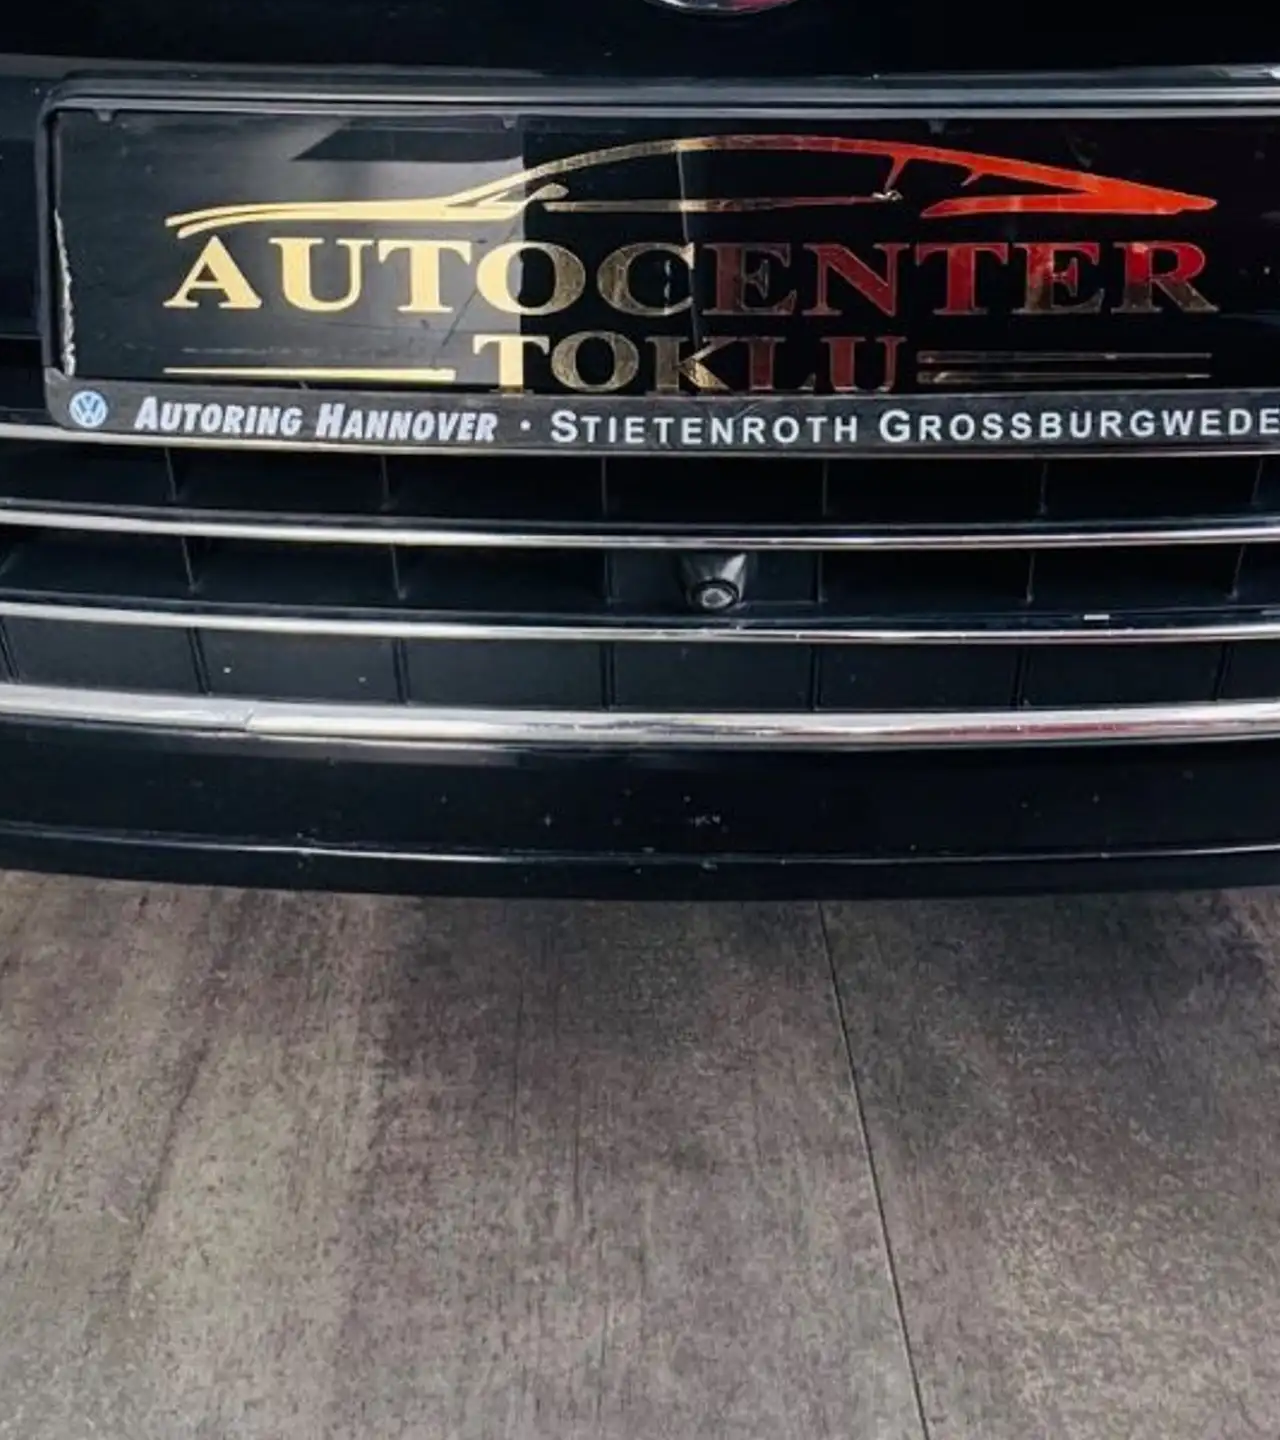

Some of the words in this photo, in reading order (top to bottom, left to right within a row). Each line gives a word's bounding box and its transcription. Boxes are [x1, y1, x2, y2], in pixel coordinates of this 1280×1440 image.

[163, 236, 1219, 317] AUTOCENTER
[472, 330, 908, 396] TOKLU
[134, 396, 302, 435] AUTORING
[316, 403, 499, 443] HANNOVER
[550, 409, 858, 445] STIETENROTH
